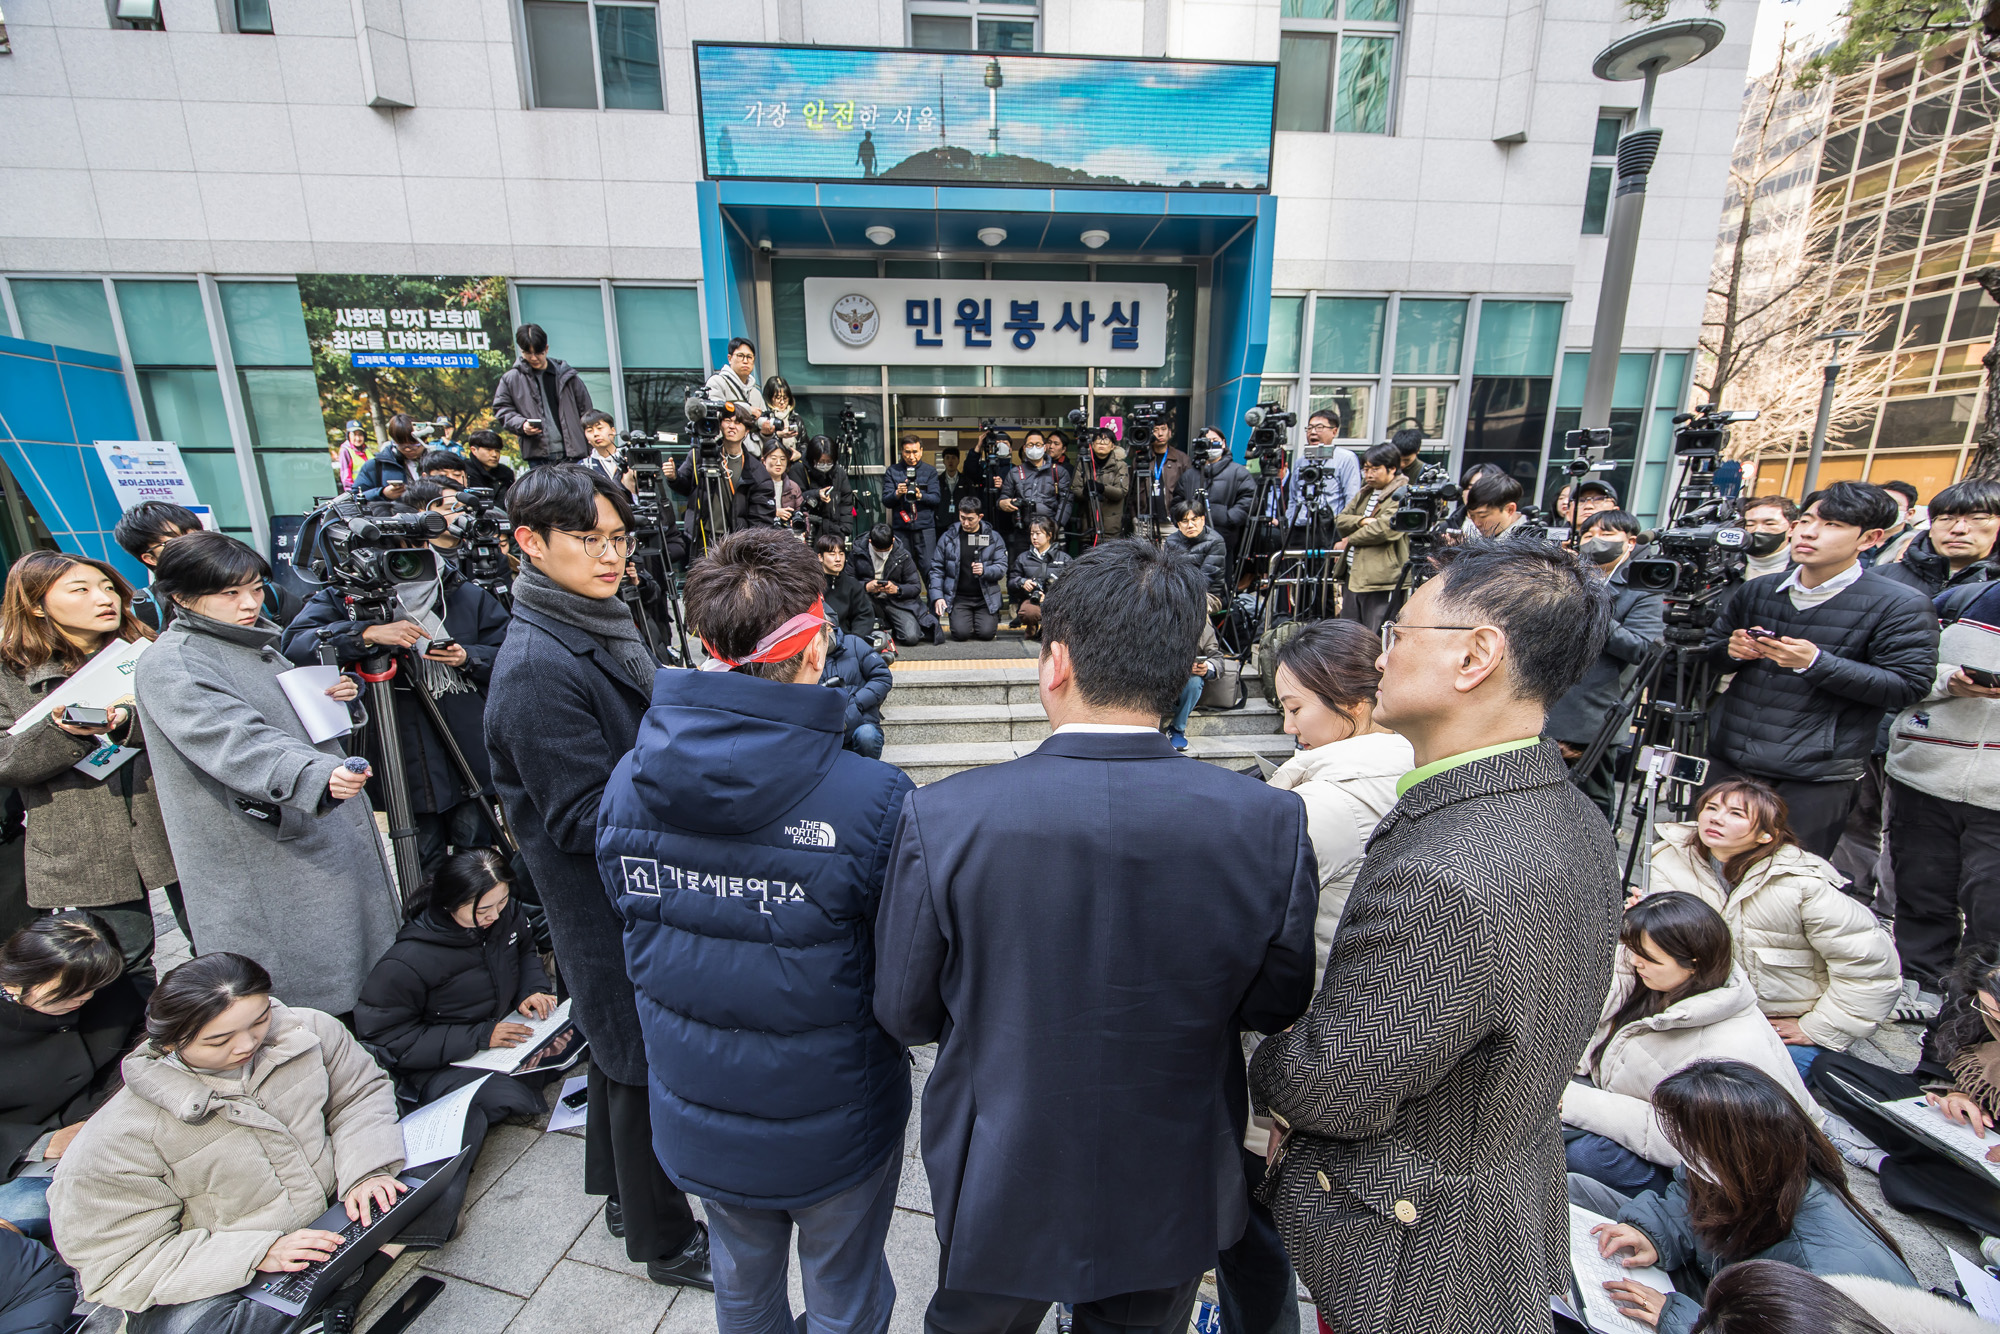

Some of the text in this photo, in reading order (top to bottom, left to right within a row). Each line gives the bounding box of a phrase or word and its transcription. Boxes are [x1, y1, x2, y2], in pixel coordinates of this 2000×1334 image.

[743, 99, 936, 132] 가장 안전한 서울
[336, 308, 482, 329] 사회적 약자 보호에
[906, 298, 1140, 350] 민원봉사실
[332, 330, 491, 351] 최선을 다하겠습니다
[412, 356, 442, 365] 노인학대
[443, 356, 458, 365] 신고
[459, 356, 473, 365] 112
[1720, 532, 1740, 540] OBS
[784, 826, 819, 838] NORTH
[800, 820, 820, 830] THE
[793, 836, 818, 846] FACE
[663, 864, 805, 915] 가로세로연구소
